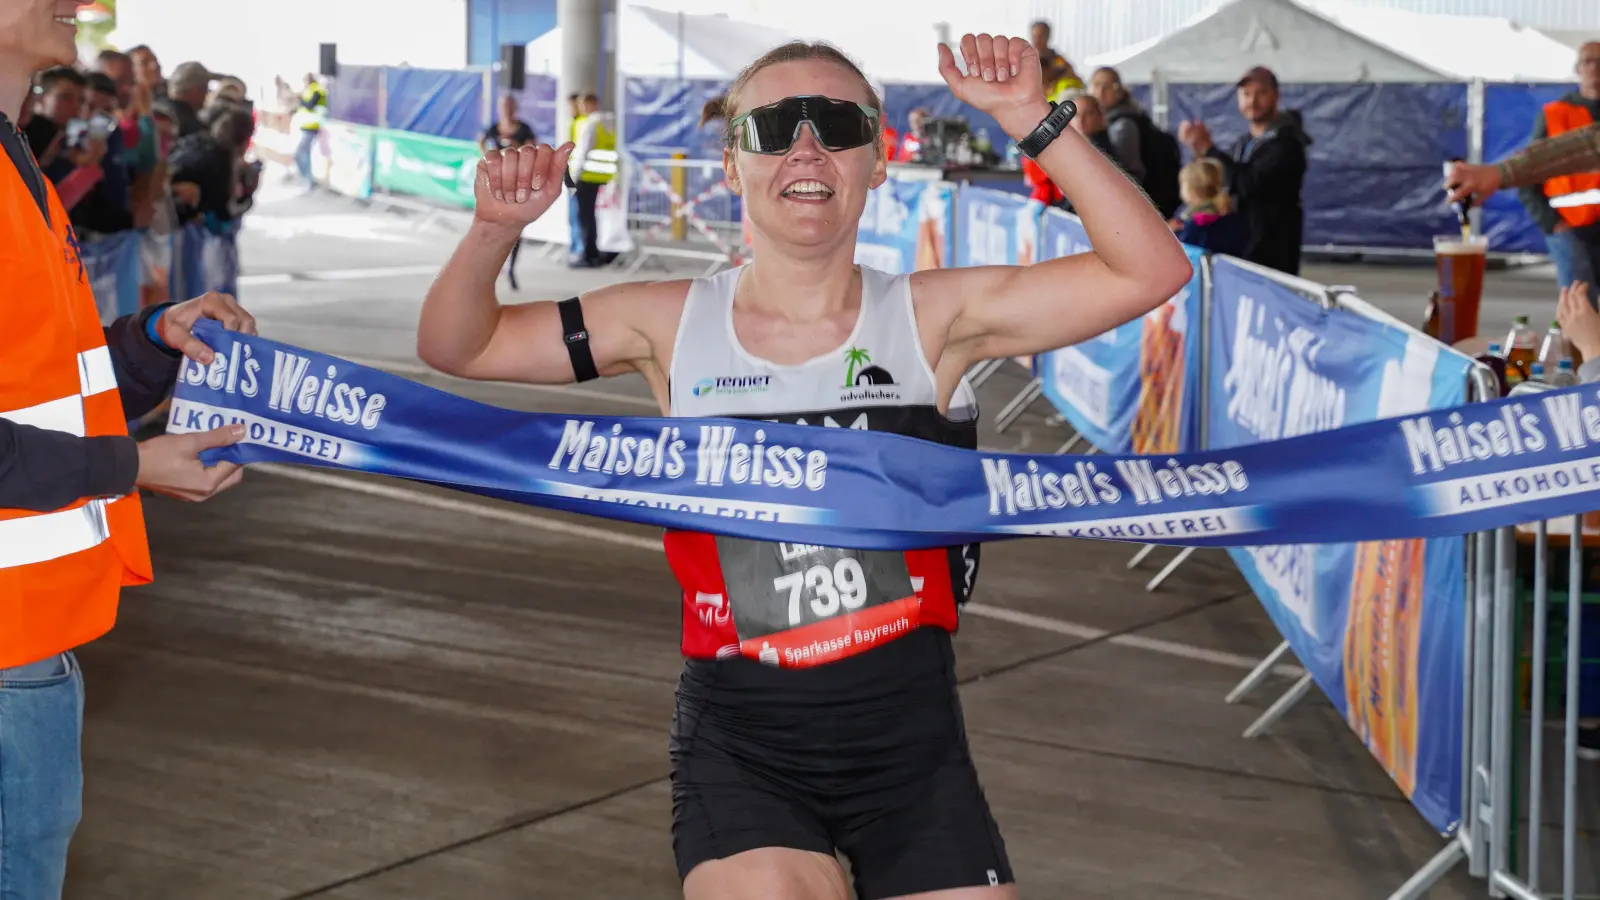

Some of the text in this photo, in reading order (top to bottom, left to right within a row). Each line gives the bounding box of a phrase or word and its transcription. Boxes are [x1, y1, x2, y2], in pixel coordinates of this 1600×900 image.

[268, 350, 387, 430] Weisse
[548, 419, 828, 491] Maisel's Weisse
[1400, 390, 1600, 475] Maisel's We
[981, 457, 1250, 516] Maisel's Weisse
[1034, 515, 1228, 538] KOHOLFREI
[773, 557, 868, 627] 739
[785, 616, 909, 662] Sparkasse Bayreuth
